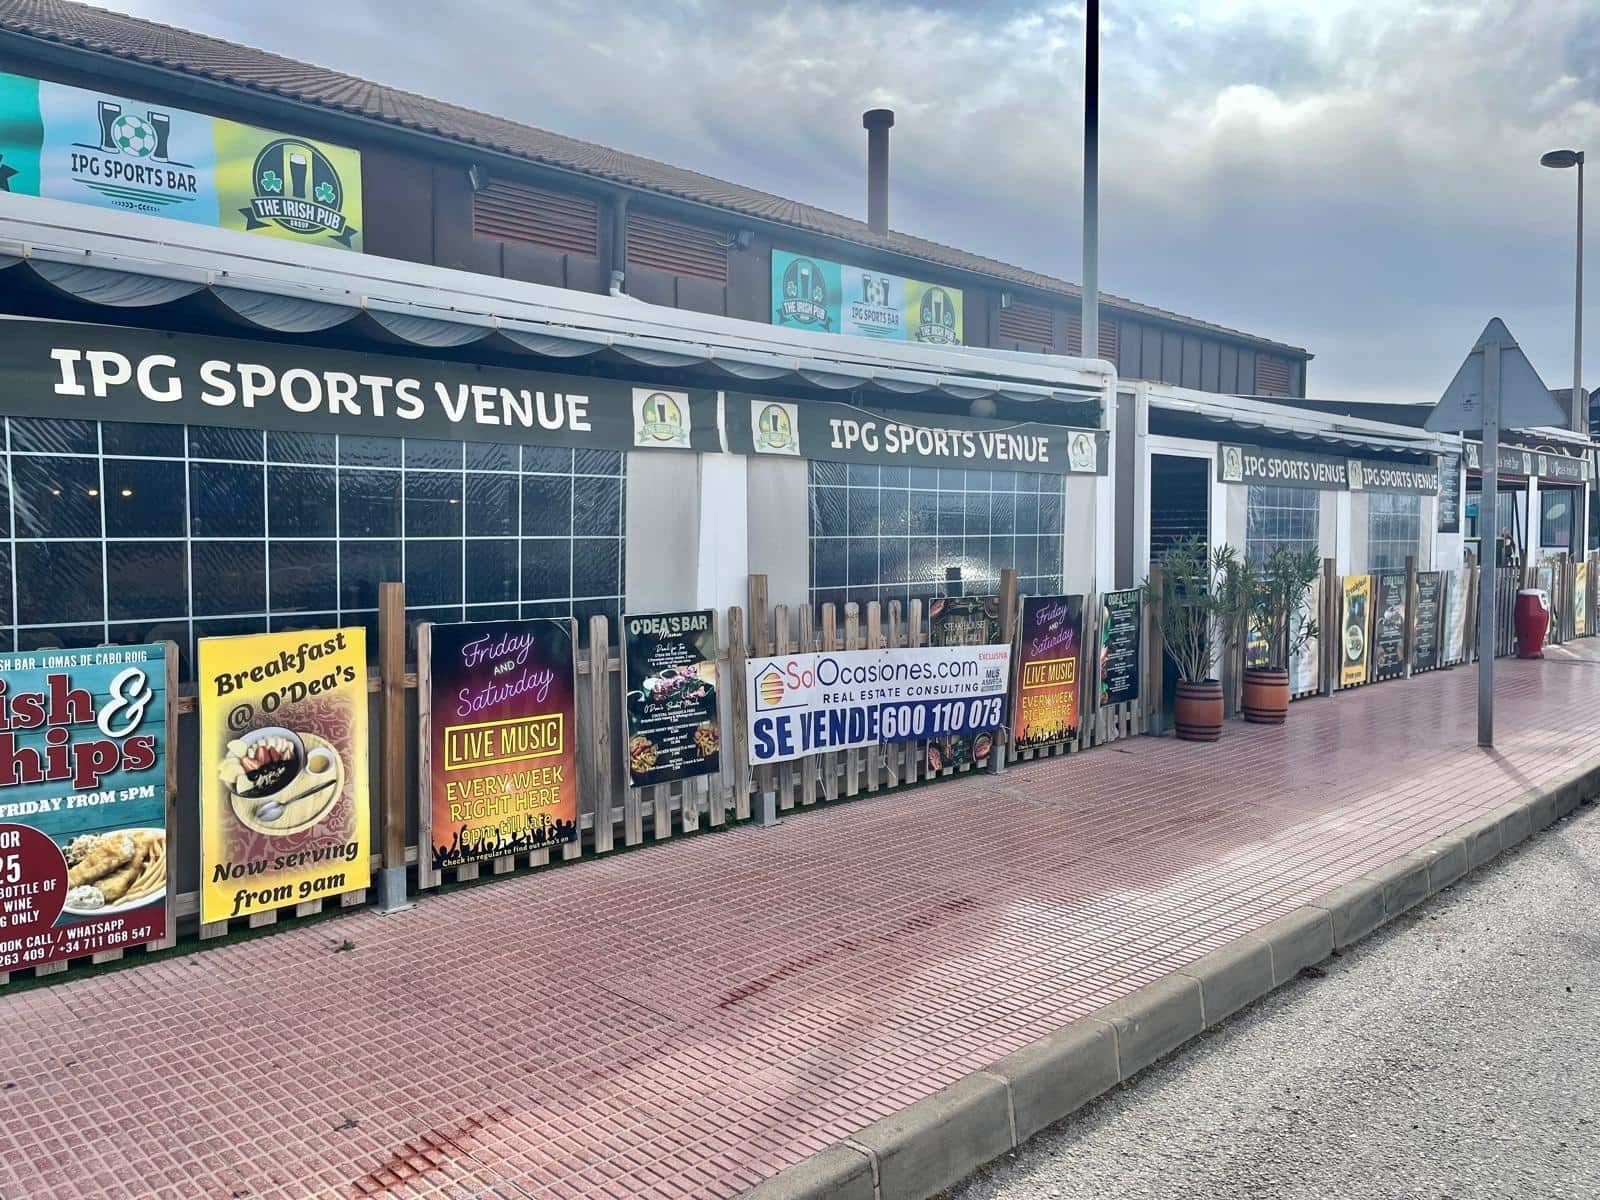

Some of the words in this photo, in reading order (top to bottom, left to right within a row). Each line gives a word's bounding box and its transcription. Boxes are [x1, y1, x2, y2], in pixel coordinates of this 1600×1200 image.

[71, 153, 100, 176] IPG
[104, 161, 163, 187] SPORTS
[167, 172, 197, 194] BAR
[255, 200, 281, 216] THE
[283, 200, 315, 220] IRISH
[316, 208, 341, 229] PUB
[851, 307, 864, 318] IPG
[864, 309, 886, 322] SPORTS
[888, 313, 899, 325] BAR
[50, 347, 183, 403] IPG
[199, 360, 425, 420] SPORTS
[434, 382, 592, 432] VENUE
[829, 418, 878, 452] IPG
[884, 423, 976, 459] SPORTS
[980, 431, 1049, 463] VENUE
[1244, 456, 1266, 477] IPG
[1267, 458, 1311, 481] SPORTS
[1312, 463, 1346, 483] VENUE
[1363, 467, 1379, 484] IPG
[1380, 470, 1412, 488] SPORTS
[1412, 473, 1438, 490] VENUE
[630, 616, 681, 636] O'DEA'S
[682, 615, 708, 632] BAR
[1036, 603, 1068, 626] Friday
[1049, 622, 1058, 631] AND
[462, 632, 534, 668] Friday
[978, 651, 1008, 661] EXCLUSIVA
[1030, 629, 1074, 657] Saturday
[15, 657, 35, 670] BAR
[42, 654, 77, 668] LOMAS
[80, 654, 92, 666] DE
[96, 653, 122, 664] CABO
[125, 651, 147, 663] ROIG
[214, 632, 347, 697] Breakfast
[494, 661, 515, 676] AND
[786, 658, 978, 690] SolOcasiones.com
[1026, 665, 1045, 684] LIVE
[1048, 661, 1074, 682] MUSIC
[97, 667, 152, 738] &
[227, 703, 255, 731] @
[261, 665, 356, 715] O'Dea's
[456, 668, 554, 717] Saturday
[823, 692, 854, 704] REAL
[860, 688, 900, 700] ESTATE
[907, 683, 979, 698] CONSULTING
[452, 730, 494, 762] LIVE
[501, 721, 557, 756] MUSIC
[753, 715, 795, 760] SE
[800, 705, 878, 752] VENDE
[882, 704, 926, 738] 600
[931, 701, 965, 732] 110
[968, 697, 1002, 727] 073
[0, 727, 156, 790] hips
[446, 774, 509, 802] EVERY
[515, 765, 564, 791] WEEK
[0, 796, 66, 818] FRIDAY
[66, 790, 116, 809] FROM
[120, 785, 155, 801] 5PM
[450, 794, 511, 822] RIGHT
[515, 786, 561, 812] HERE
[462, 824, 496, 846] 9pm
[500, 815, 520, 836] till
[525, 813, 552, 831] late
[212, 858, 268, 882] Now
[273, 840, 359, 871] serving
[442, 858, 465, 867] Check
[477, 850, 502, 862] regular
[514, 845, 528, 853] find
[529, 842, 540, 850] out
[0, 882, 39, 899] BOTTLE
[44, 879, 56, 892] OF
[4, 897, 32, 912] WINE
[231, 889, 292, 917] from
[299, 872, 346, 899] 9am
[12, 910, 40, 926] ONLY
[26, 933, 54, 948] CALL
[57, 931, 63, 943] /
[66, 919, 124, 940] WHATSAPP
[23, 948, 44, 962] 409
[48, 945, 54, 958] /
[60, 942, 80, 954] +34
[84, 938, 103, 950] 711
[108, 931, 128, 944] 068
[132, 926, 152, 939] 547
